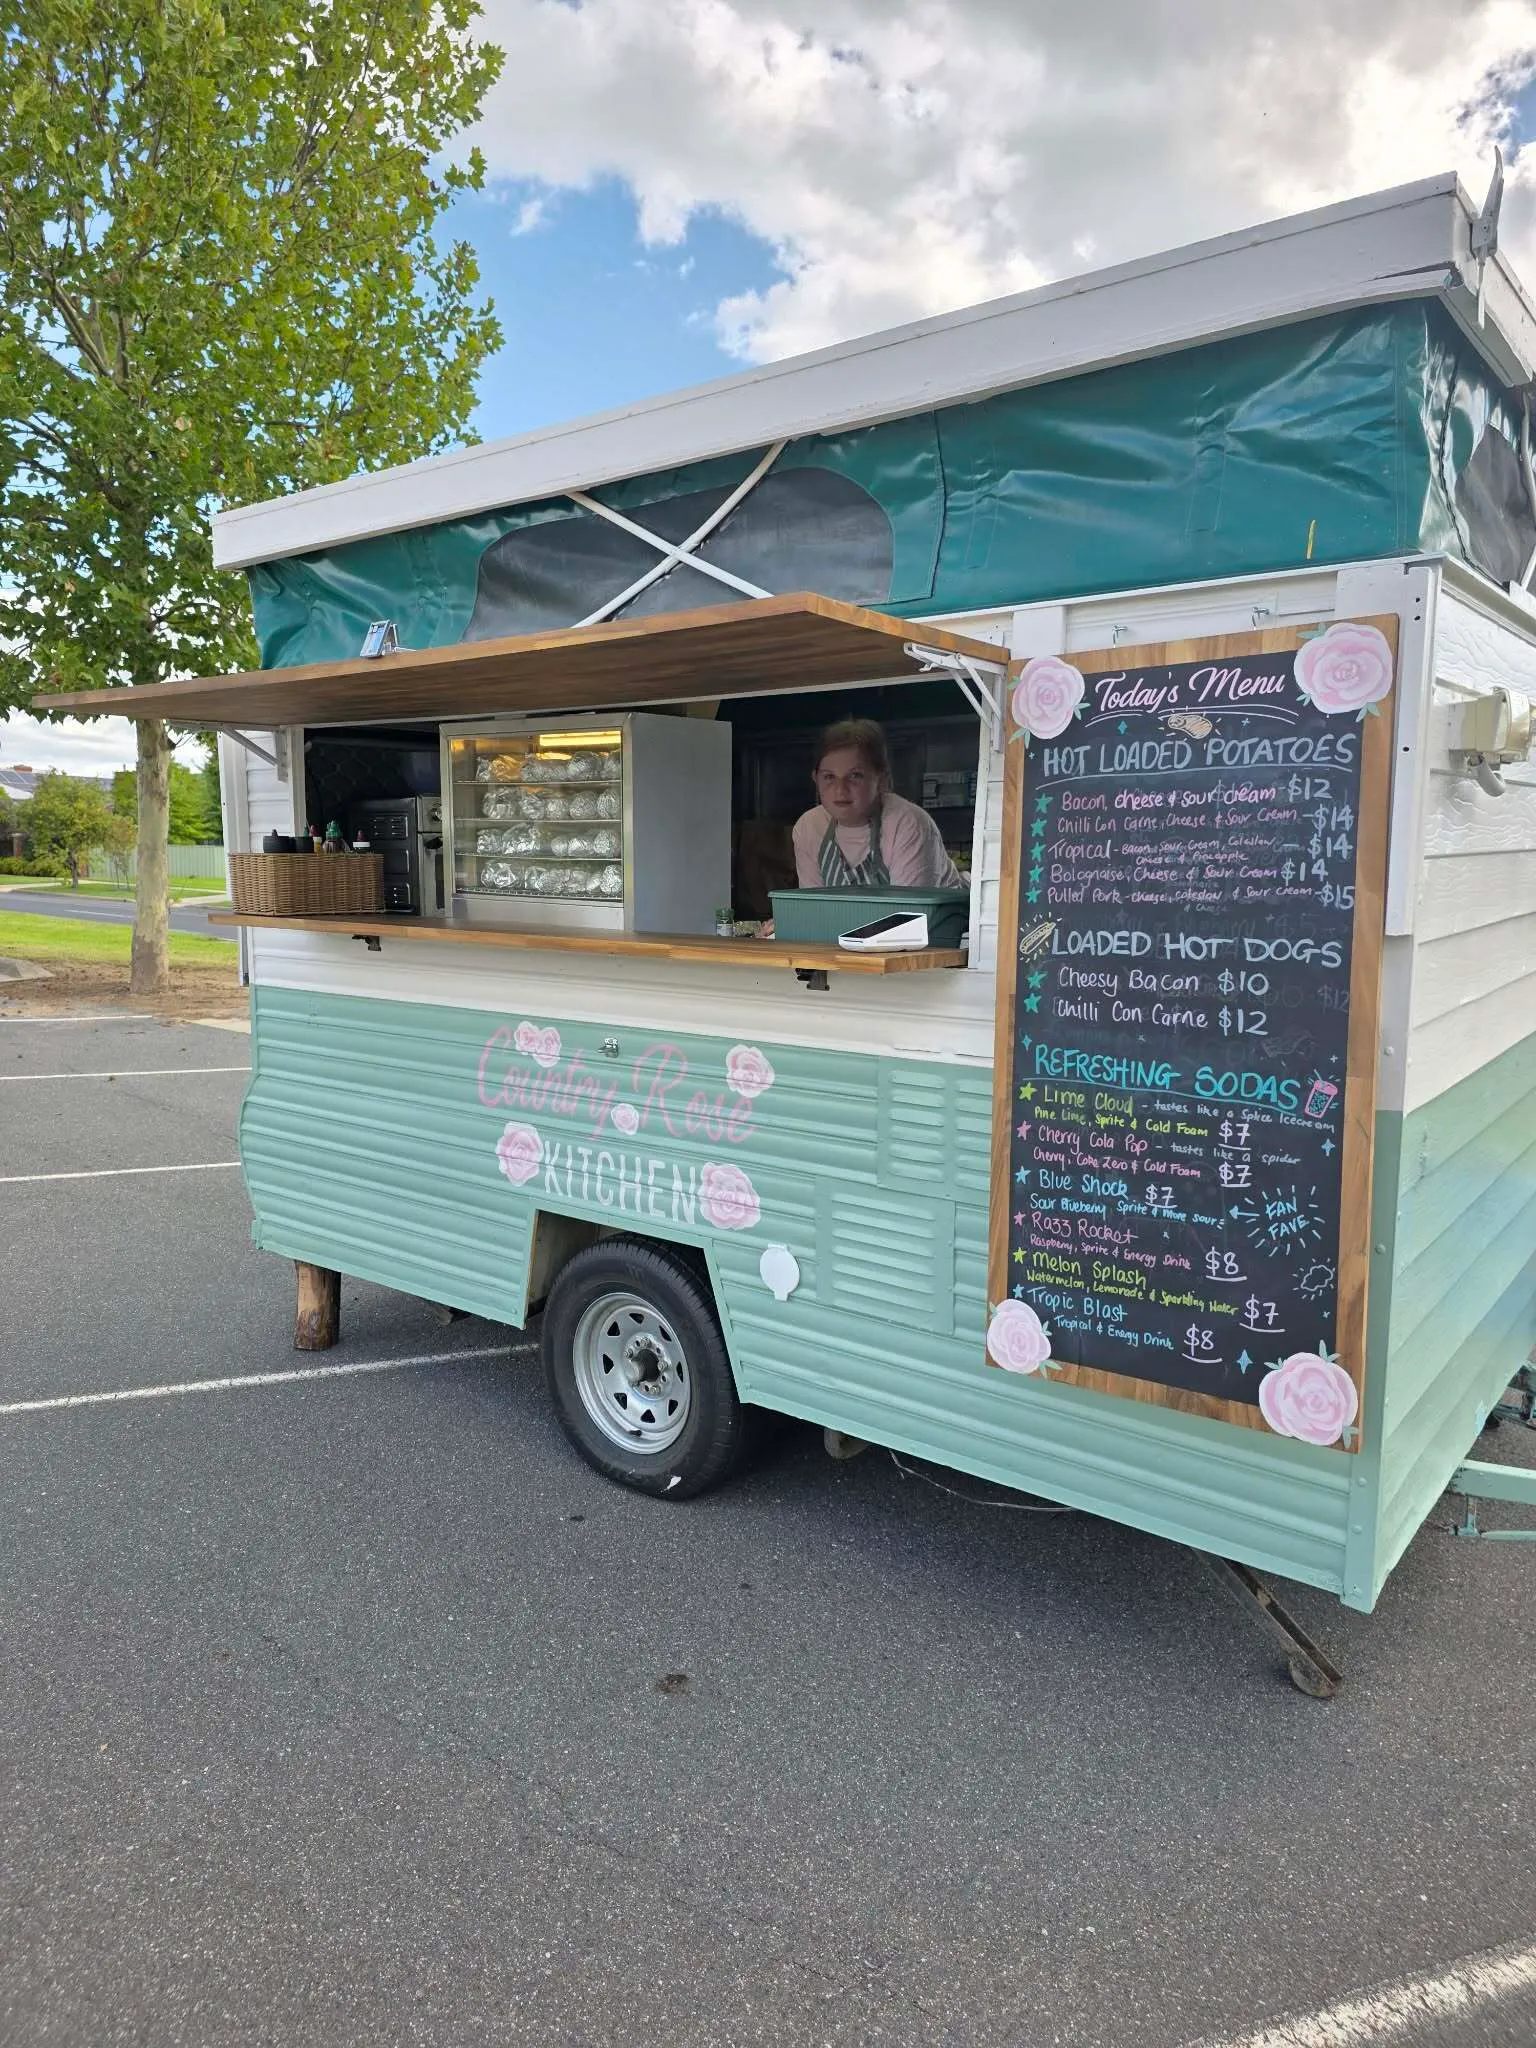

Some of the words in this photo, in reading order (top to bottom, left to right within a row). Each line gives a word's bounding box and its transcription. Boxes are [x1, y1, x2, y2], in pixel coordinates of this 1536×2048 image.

[1095, 672, 1178, 712] Today's
[1189, 667, 1285, 702] Menu
[1044, 745, 1090, 776] HOT
[1100, 739, 1192, 773] LOADED
[1206, 733, 1357, 764] POTATOES
[1048, 838, 1111, 863] Tropical
[1307, 833, 1353, 859] $14
[1048, 887, 1084, 904] Pulled
[1051, 929, 1151, 957] LOADED
[1165, 932, 1234, 960] HOT
[1243, 937, 1342, 969] DOGS
[1059, 966, 1118, 997] Cheesy
[1128, 969, 1199, 991] Bacon
[1217, 968, 1269, 995] $10
[1056, 998, 1100, 1022] Chilli
[1112, 1000, 1142, 1023] Con
[1152, 1004, 1208, 1028] Carne
[1218, 1005, 1268, 1036] $12
[478, 1026, 620, 1141] Country
[632, 1042, 759, 1144] Rose
[1035, 1044, 1182, 1089] REFRESHING
[1195, 1066, 1300, 1110] SODAS
[1044, 1084, 1085, 1108] Lime
[1095, 1092, 1134, 1117] Cloud
[1154, 1099, 1189, 1114] tastes
[1197, 1104, 1219, 1117] like
[1226, 1110, 1234, 1118] a
[1034, 1106, 1057, 1120] Pine
[1145, 1118, 1171, 1133] Cold
[1177, 1122, 1208, 1137] Foam
[1219, 1119, 1251, 1146] $7
[1038, 1124, 1080, 1155] Cherry
[1089, 1132, 1115, 1149] Cola
[1125, 1134, 1148, 1156] Pop
[1170, 1142, 1204, 1157] tastes
[1213, 1148, 1234, 1161] like
[1242, 1152, 1251, 1162] a
[544, 1141, 697, 1225] KITCHEN
[1040, 1169, 1073, 1190] Blue
[1081, 1173, 1129, 1199] Shock
[1145, 1184, 1175, 1206] $7
[1103, 1156, 1128, 1170] Zero
[1143, 1158, 1166, 1173] Cold
[1218, 1161, 1252, 1184] $7
[1030, 1193, 1055, 1209] Sour
[1266, 1195, 1297, 1220] FAN
[1078, 1218, 1139, 1244] Rocket
[1268, 1214, 1309, 1240] FAVE
[1033, 1251, 1082, 1276] Melon
[1092, 1261, 1147, 1290] Splash
[1123, 1248, 1156, 1268] Energy
[1205, 1246, 1239, 1276] $8
[1026, 1286, 1074, 1313] Tropic
[1083, 1297, 1128, 1322] Blast
[1244, 1294, 1279, 1328] $7
[1054, 1314, 1092, 1332] Tropical
[1107, 1324, 1139, 1347] Energy
[1144, 1331, 1174, 1350] Drink
[1184, 1323, 1214, 1356] $8
